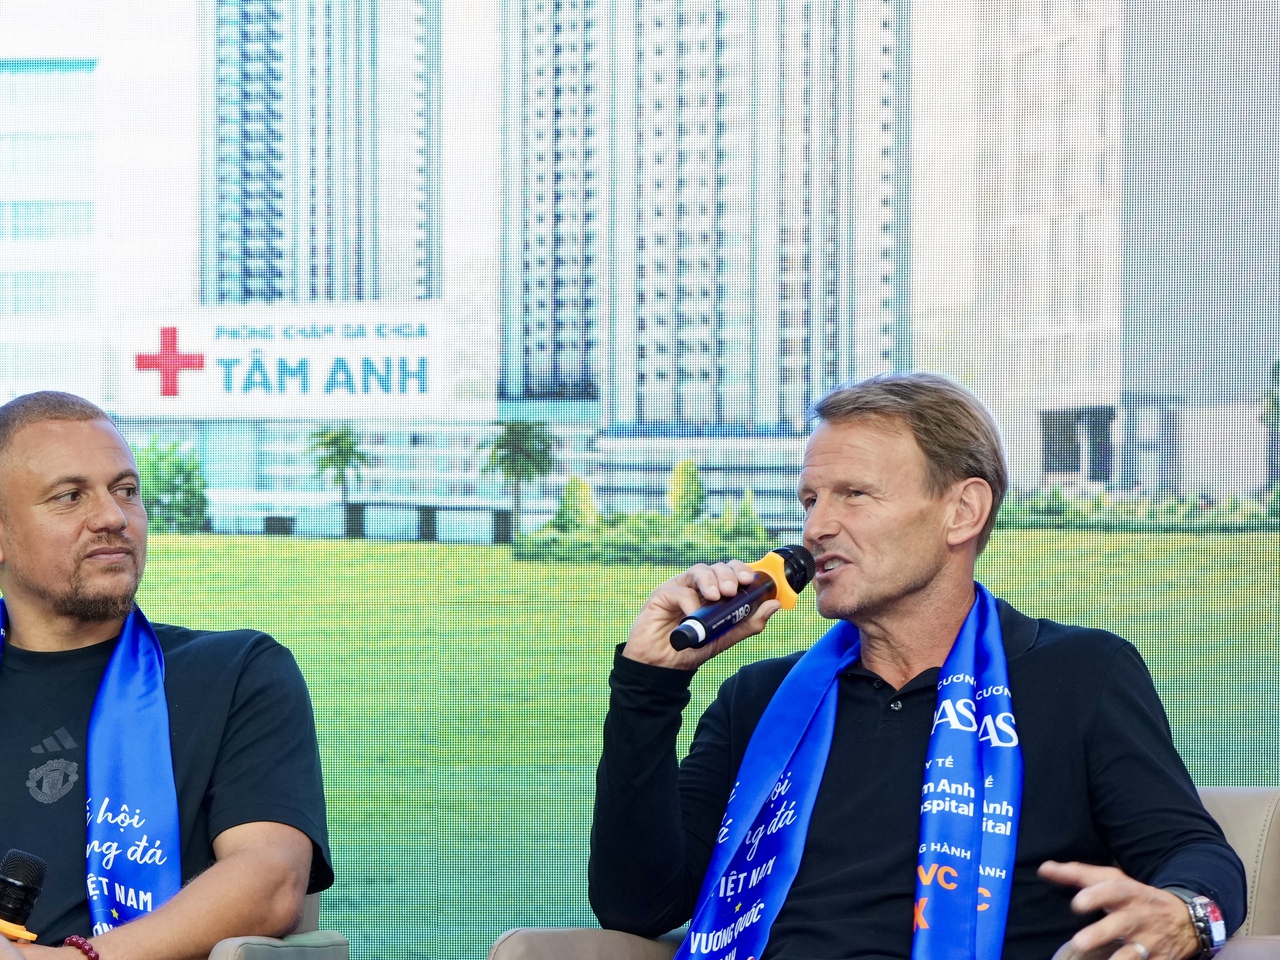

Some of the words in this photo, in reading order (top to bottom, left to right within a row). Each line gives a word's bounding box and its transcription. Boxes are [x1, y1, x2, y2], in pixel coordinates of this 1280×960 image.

[214, 346, 311, 394] TÂM
[323, 355, 428, 395] ANH
[936, 754, 955, 768] TẾ
[37, 789, 67, 801] UNITED
[936, 778, 976, 799] Anh
[96, 796, 146, 834] hội
[766, 800, 798, 836] đá
[126, 834, 168, 866] đá
[930, 841, 972, 860] HÀNH
[114, 882, 153, 913] NAM
[718, 870, 748, 902] IỆT
[690, 922, 735, 954] VƯƠNG
[733, 898, 765, 940] QUỐC
